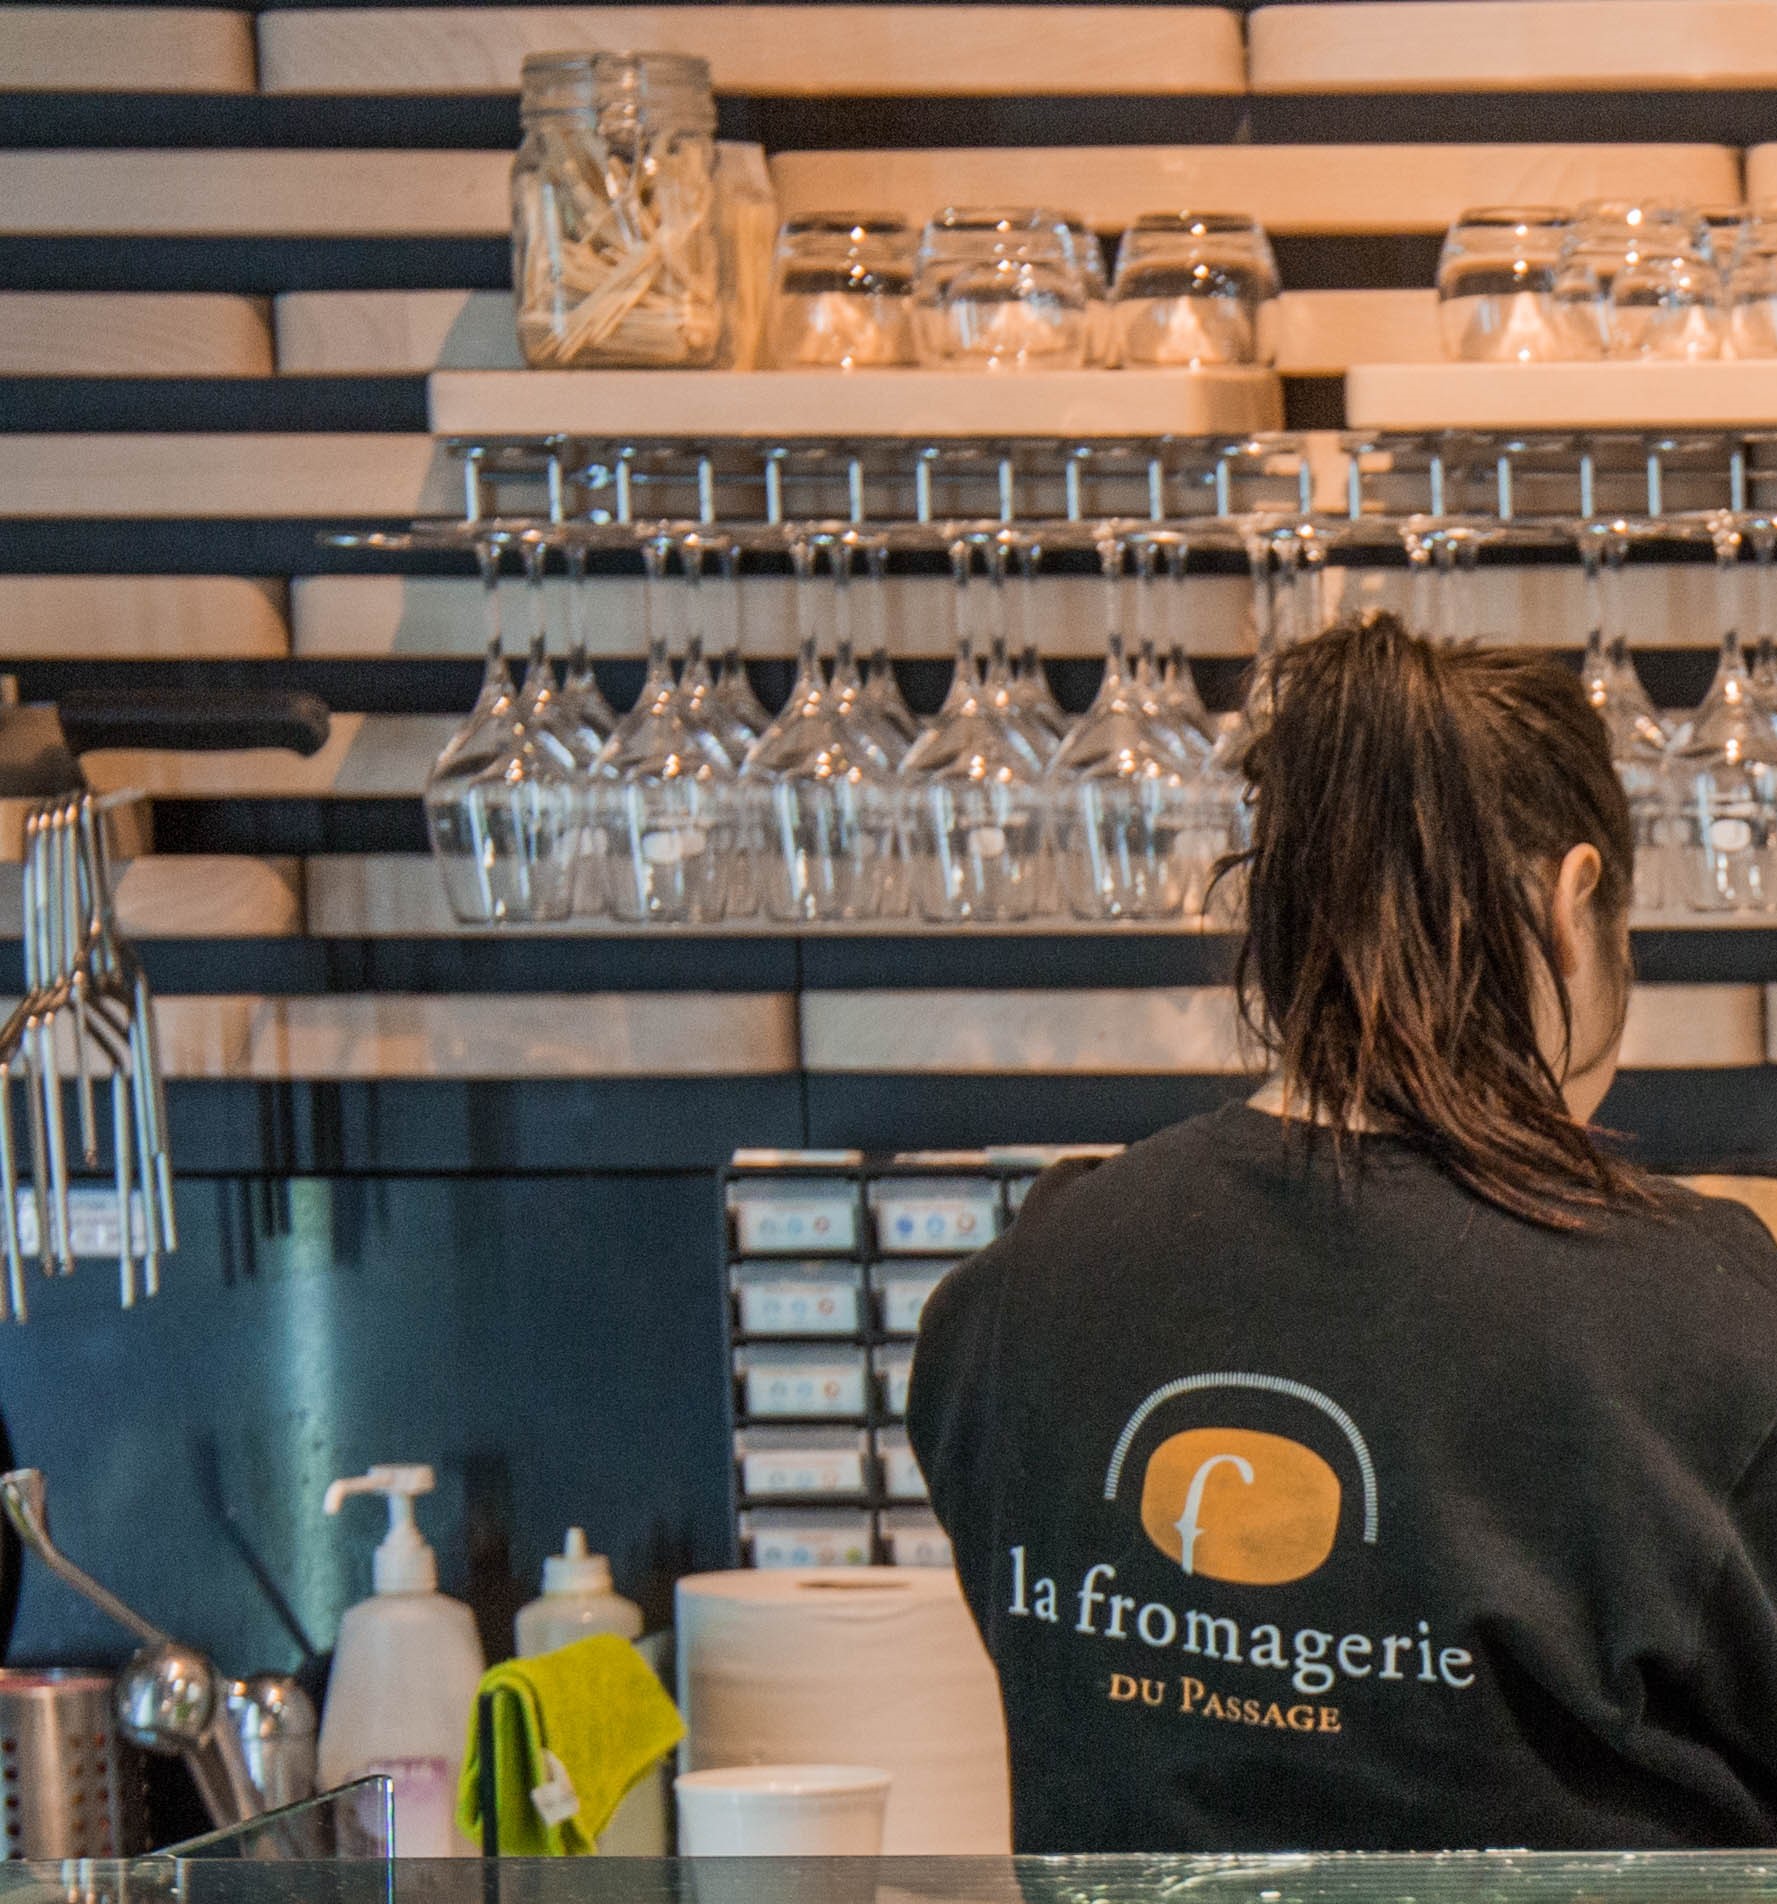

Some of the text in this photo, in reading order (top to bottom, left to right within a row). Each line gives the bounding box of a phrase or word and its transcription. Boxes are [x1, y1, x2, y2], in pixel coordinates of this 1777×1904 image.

[1008, 1546, 1475, 1694] la fromagerie
[1109, 1673, 1165, 1705] DU
